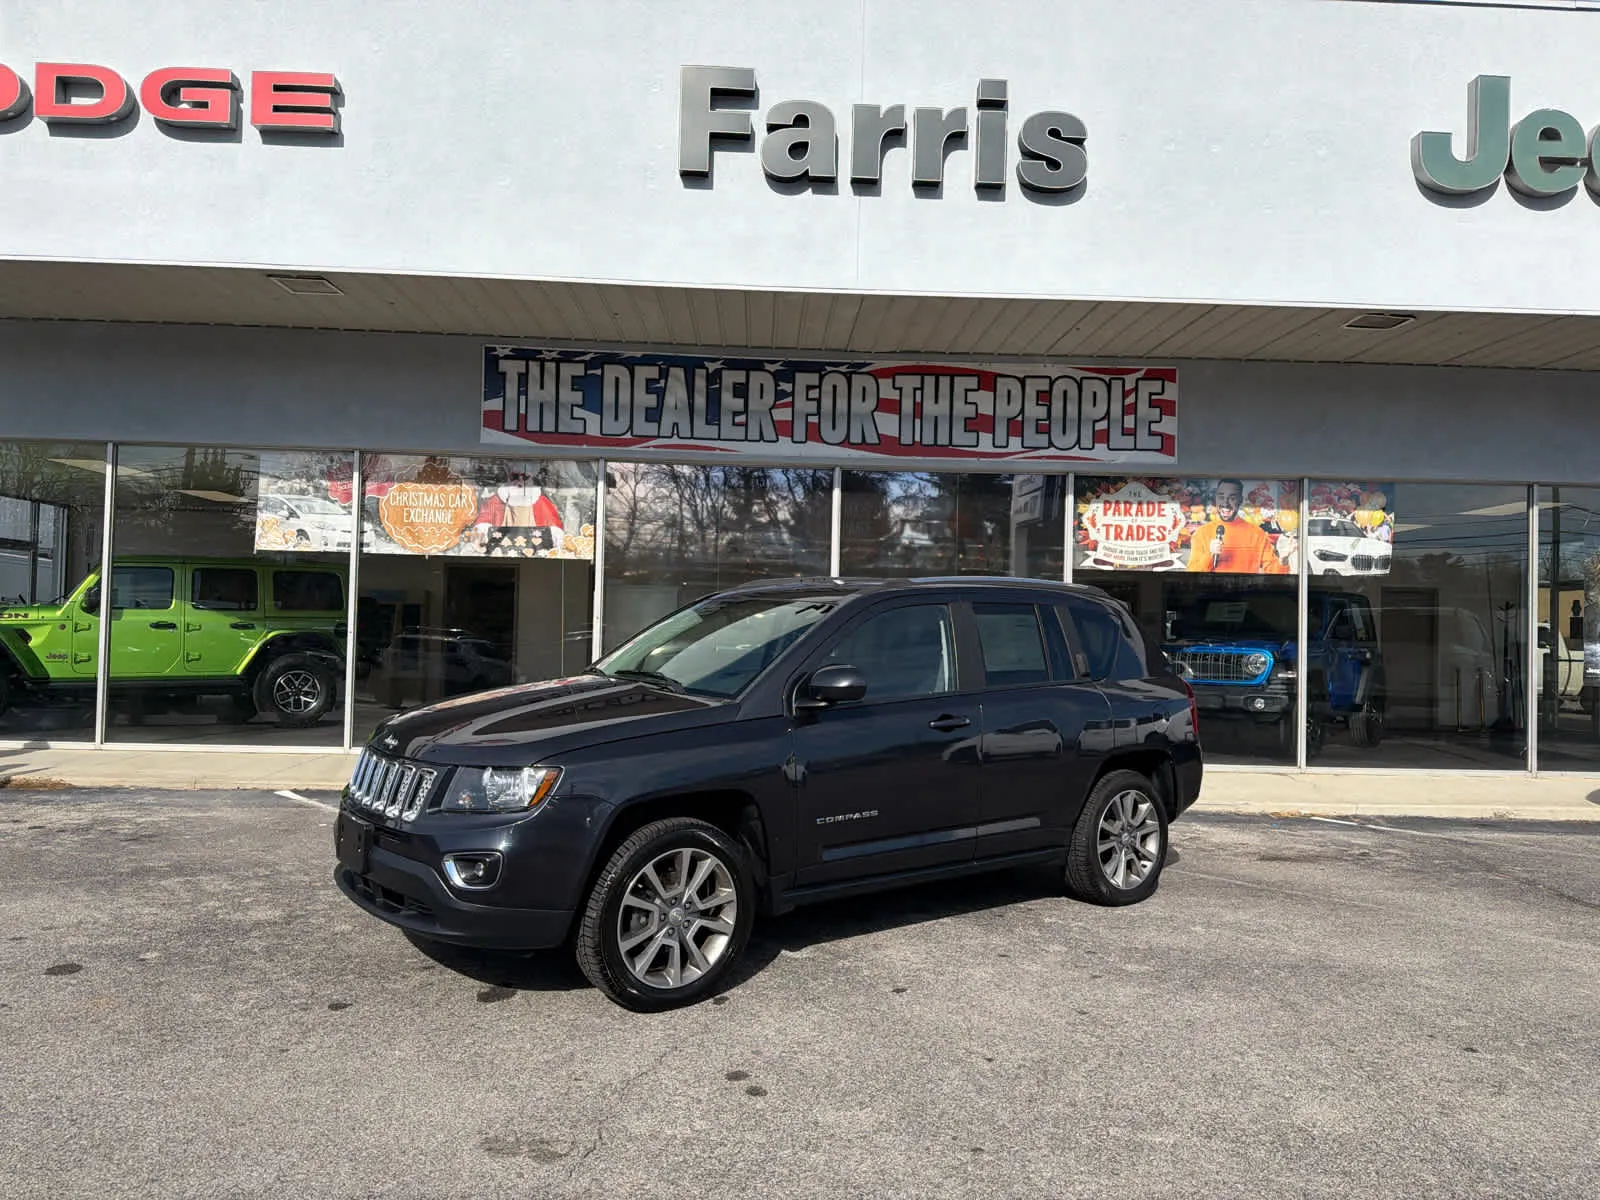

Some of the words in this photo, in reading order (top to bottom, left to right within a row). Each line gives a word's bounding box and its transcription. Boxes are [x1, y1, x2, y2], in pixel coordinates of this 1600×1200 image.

[678, 64, 1089, 193] Farris
[1410, 75, 1600, 196] Je
[499, 358, 587, 433] THE
[600, 363, 779, 443] DEALER
[791, 369, 881, 446] FOR
[893, 373, 981, 448] THE
[992, 375, 1165, 450] PEOPLE
[390, 491, 446, 508] CHRISTMAS
[448, 493, 468, 508] CAR
[403, 508, 454, 524] EXCHANGE
[1102, 500, 1167, 517] PARADE
[1102, 524, 1167, 541] TRADES
[816, 810, 879, 824] COMPASS
